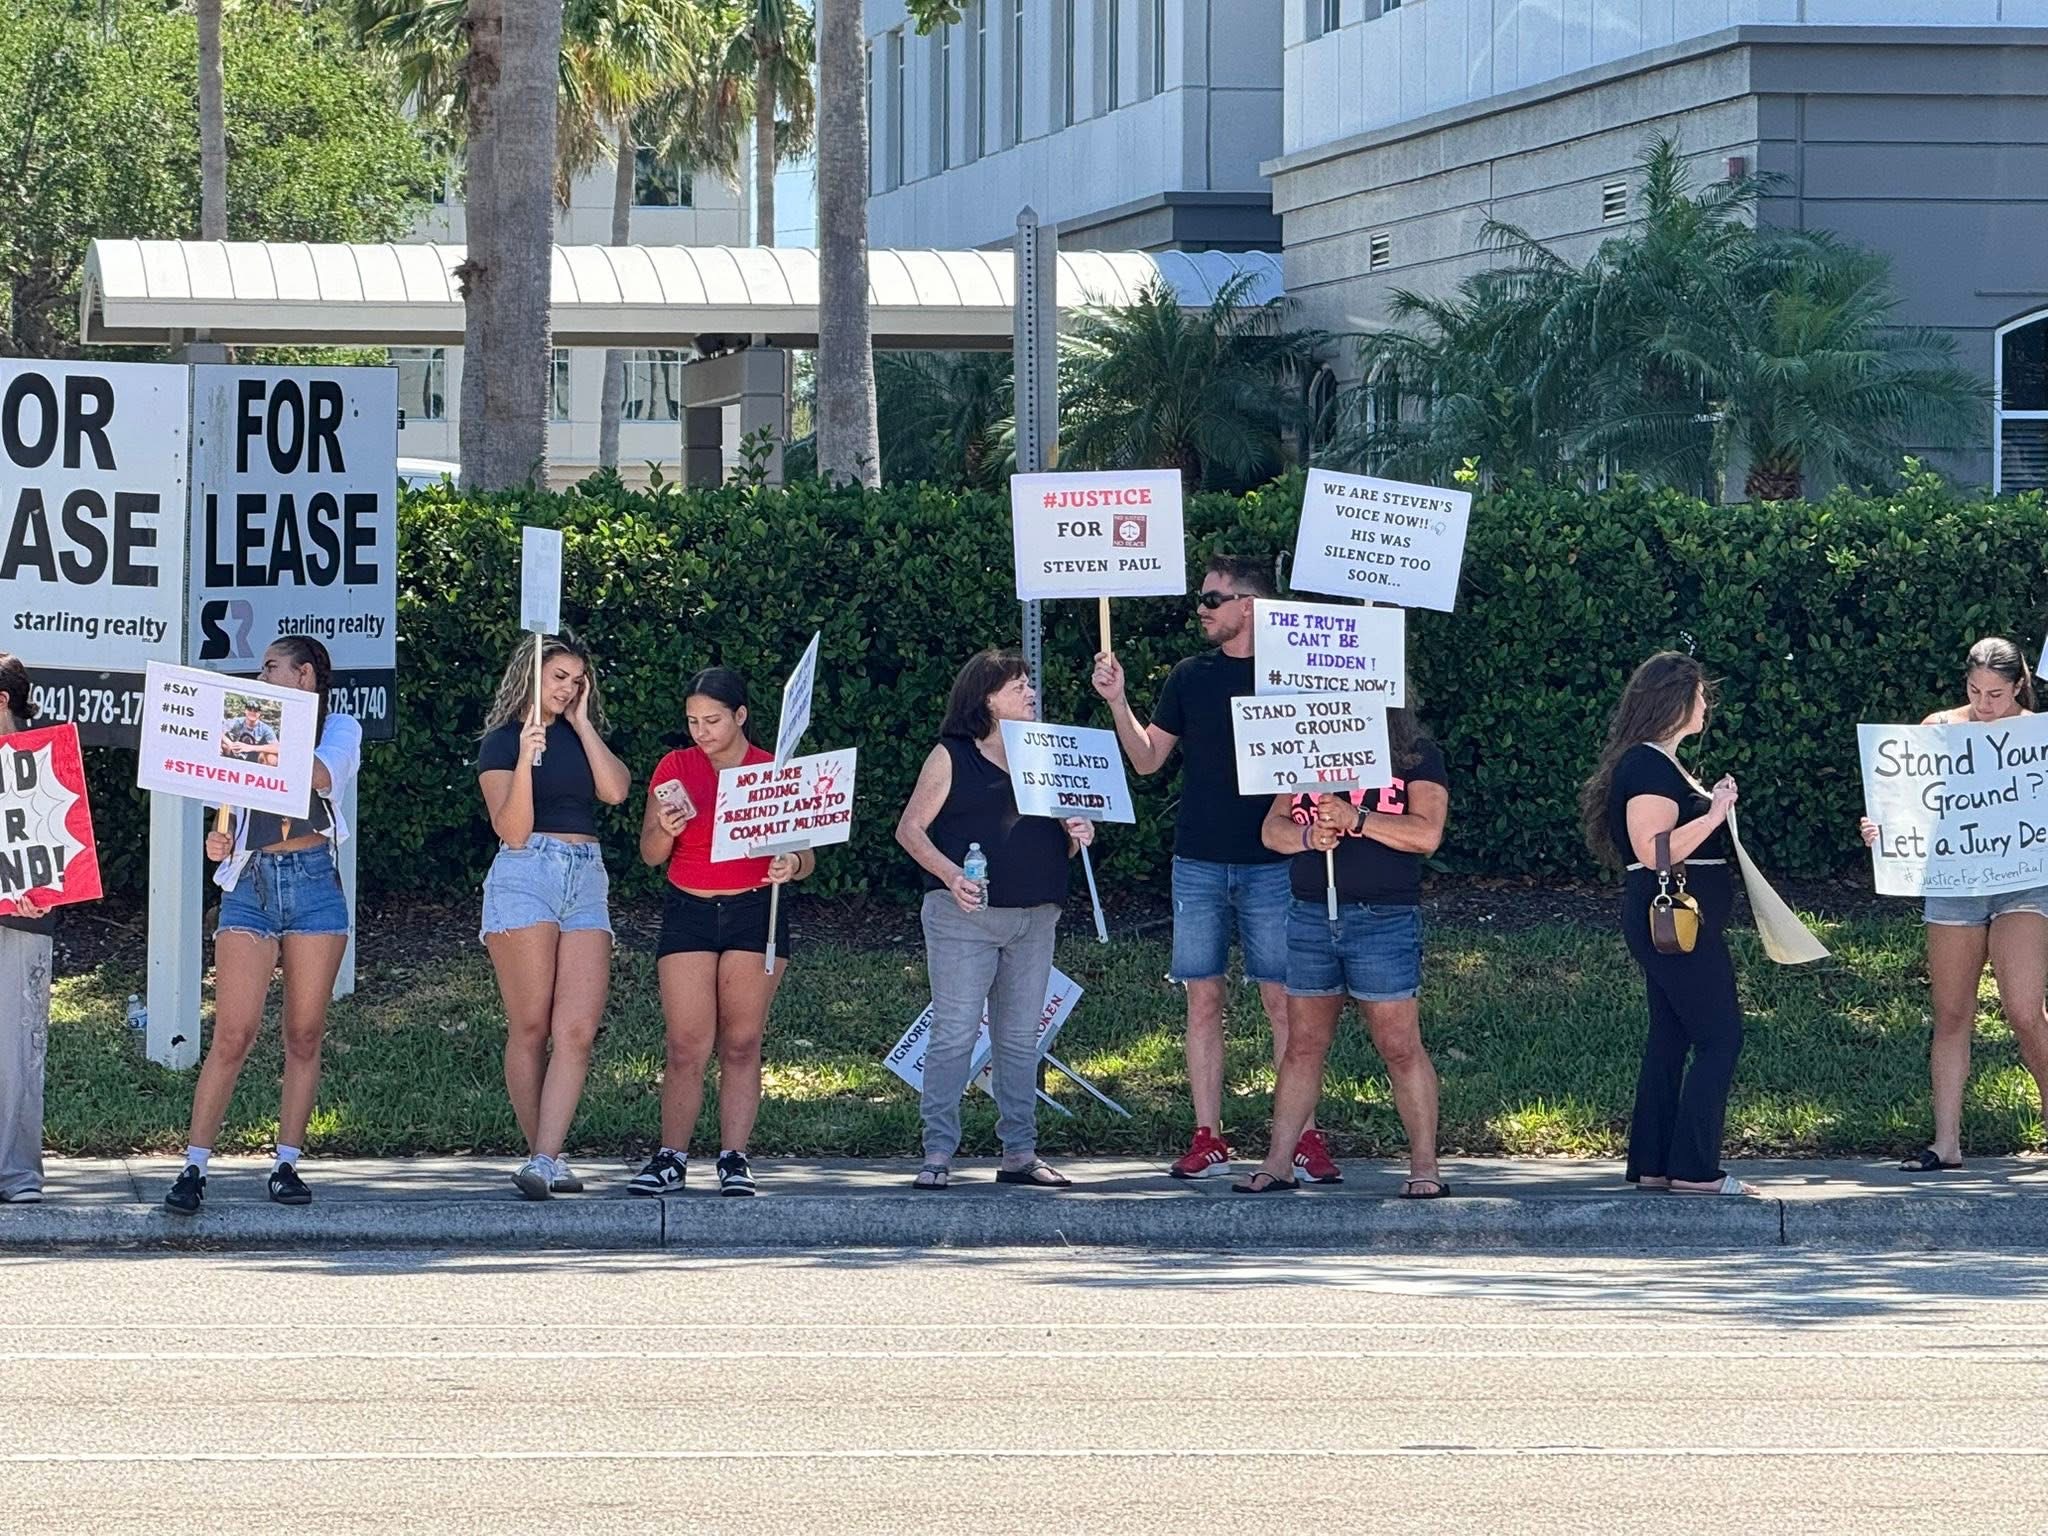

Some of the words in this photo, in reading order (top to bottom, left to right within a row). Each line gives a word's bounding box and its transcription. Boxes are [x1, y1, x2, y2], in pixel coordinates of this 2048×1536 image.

[2, 372, 117, 471] OR
[236, 378, 346, 475] FOR
[1043, 488, 1151, 508] #JUSTICE
[1323, 482, 1346, 496] WE
[1350, 488, 1379, 501] ARE
[1383, 492, 1453, 513] STEVEN'S
[1335, 505, 1380, 521] VOICE
[1383, 512, 1429, 529] NOW!!
[0, 487, 161, 588] ASE
[1057, 521, 1103, 537] FOR
[1350, 528, 1376, 543] HIS
[1380, 533, 1411, 548] WAS
[205, 491, 379, 588] LEASE
[1043, 560, 1108, 574] STEVEN
[1119, 558, 1161, 571] PAUL
[1324, 545, 1395, 565] SILENCED
[1400, 556, 1431, 571] TOO
[1347, 569, 1400, 587] SOON...
[13, 611, 99, 640] starling
[103, 615, 168, 643] realty
[277, 613, 335, 640] starling
[338, 613, 385, 639] realty
[1269, 612, 1299, 627] THE
[1303, 614, 1356, 632] TRUTH
[1287, 631, 1330, 647] CANT
[1339, 633, 1359, 648] BE
[163, 682, 198, 697] #SAY
[1268, 669, 1349, 692] #JUSTICE
[78, 688, 145, 726] 378-17
[162, 702, 195, 718] #HIS
[1306, 701, 1352, 717] YOUR
[160, 723, 209, 741] #NAME
[1024, 732, 1078, 749] JUSTICE
[1249, 742, 1266, 756] IS
[1271, 740, 1305, 755] NOT
[1309, 739, 1320, 753] A
[1874, 737, 1975, 777] Stand
[1985, 732, 2048, 770] Your
[1053, 753, 1108, 769] DELAYED
[1302, 750, 1376, 769] LICENSE
[164, 758, 240, 784] #STEVEN
[244, 773, 288, 793] PAUL
[736, 772, 758, 788] NO
[1022, 772, 1035, 785] IS
[1038, 773, 1090, 789] JUSTICE
[1273, 771, 1297, 785] TO
[1316, 768, 1360, 782] KILL
[747, 782, 800, 803] HIDING
[723, 804, 779, 824] BEHIND
[783, 795, 822, 814] LAWS
[825, 792, 846, 808] TO
[729, 819, 790, 840] COMMIT
[792, 809, 850, 832] MURDER
[1877, 825, 1927, 858] Let
[1935, 837, 1955, 856] a
[1959, 822, 2011, 858] Jury
[2019, 820, 2047, 849] De
